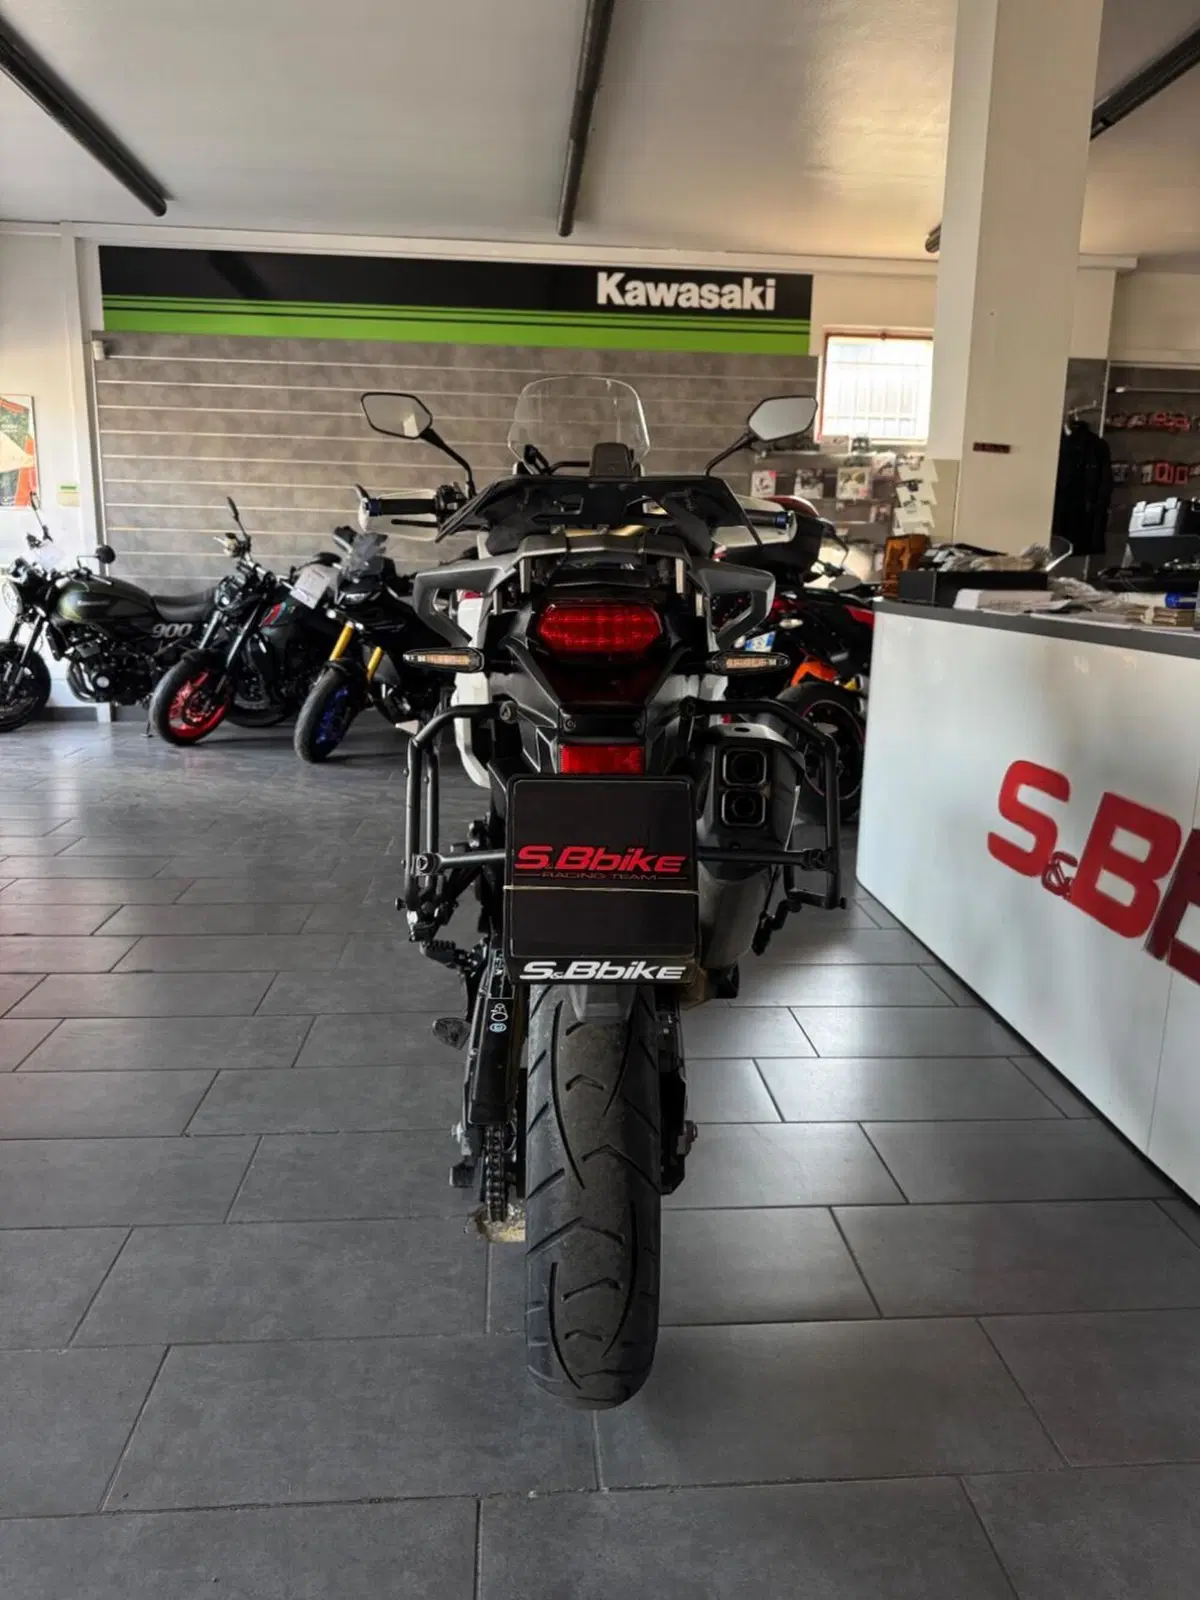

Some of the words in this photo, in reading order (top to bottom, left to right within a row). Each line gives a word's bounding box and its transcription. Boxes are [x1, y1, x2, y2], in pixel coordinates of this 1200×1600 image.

[597, 272, 776, 311] Kawasaki
[151, 623, 193, 639] 900
[612, 873, 657, 881] TEAM
[519, 961, 687, 980] S&Bbike
